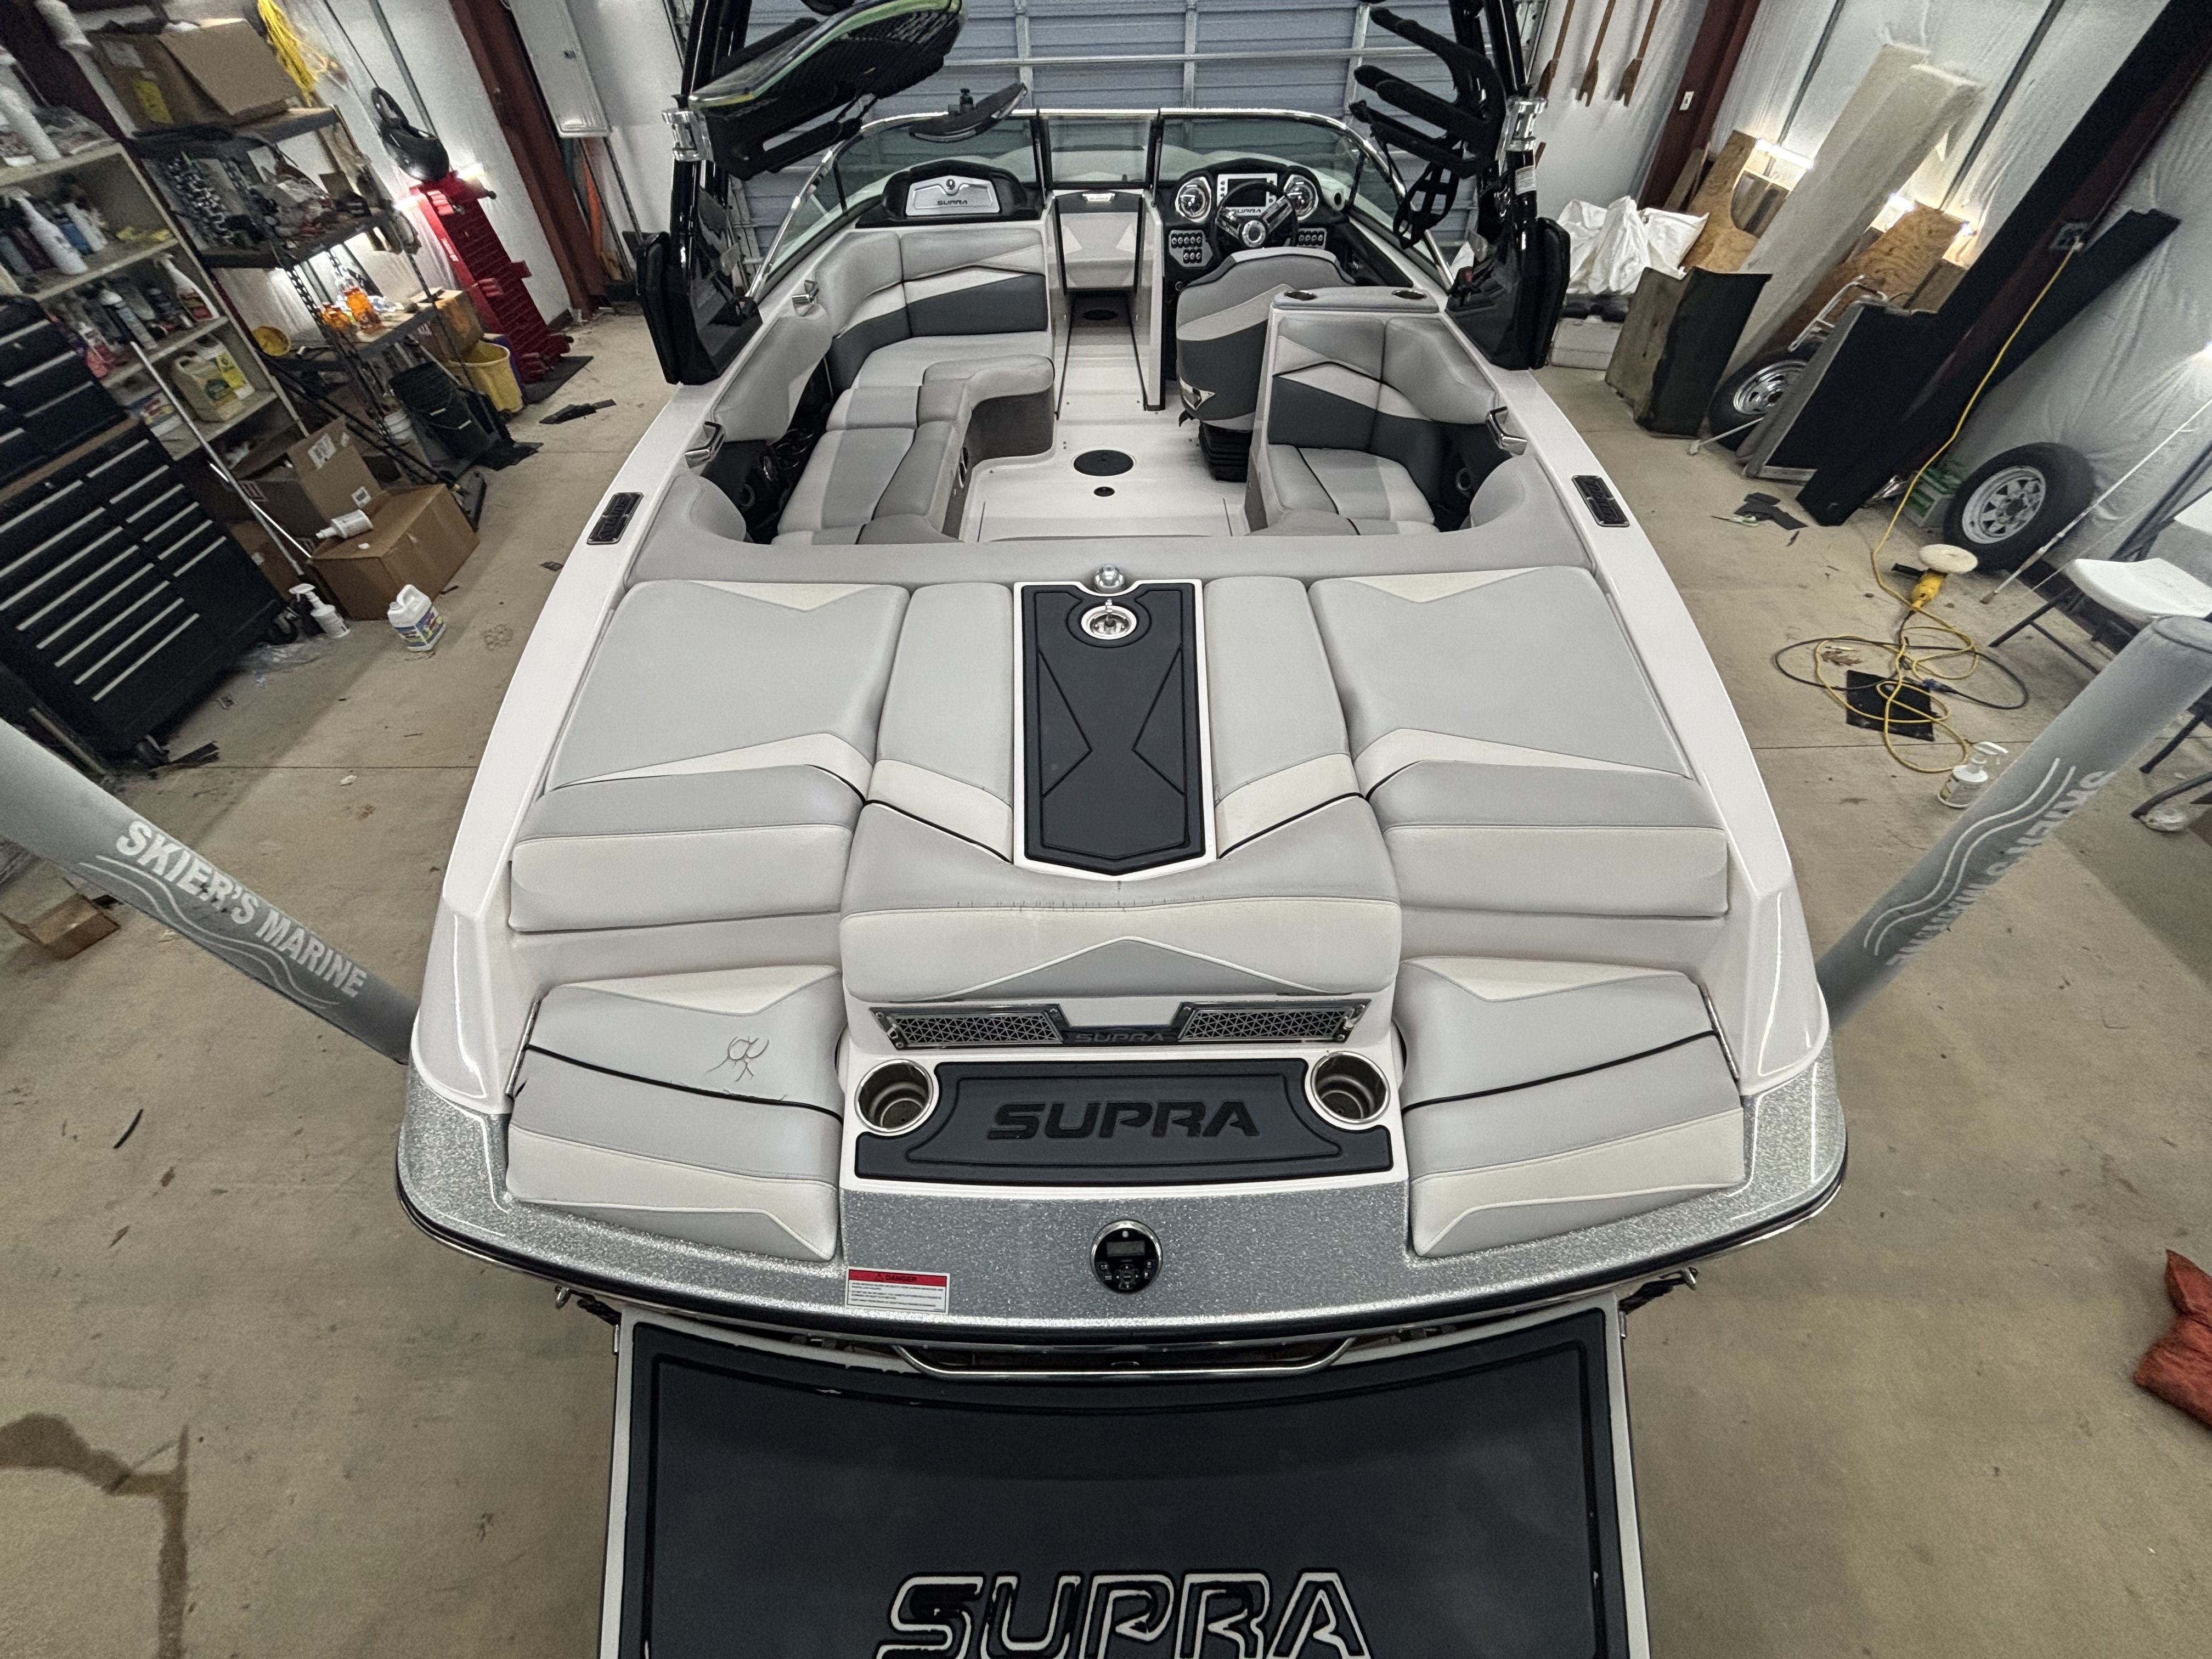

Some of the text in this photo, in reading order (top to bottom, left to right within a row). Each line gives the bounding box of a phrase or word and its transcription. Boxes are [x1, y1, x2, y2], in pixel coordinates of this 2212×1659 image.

[116, 821, 366, 998] SKIER'S MARINE
[1075, 1032, 1164, 1042] SUPRA
[987, 1101, 1260, 1139] SUPRA
[885, 1274, 917, 1282] DANGER
[876, 1571, 1373, 1659] SUPRA
